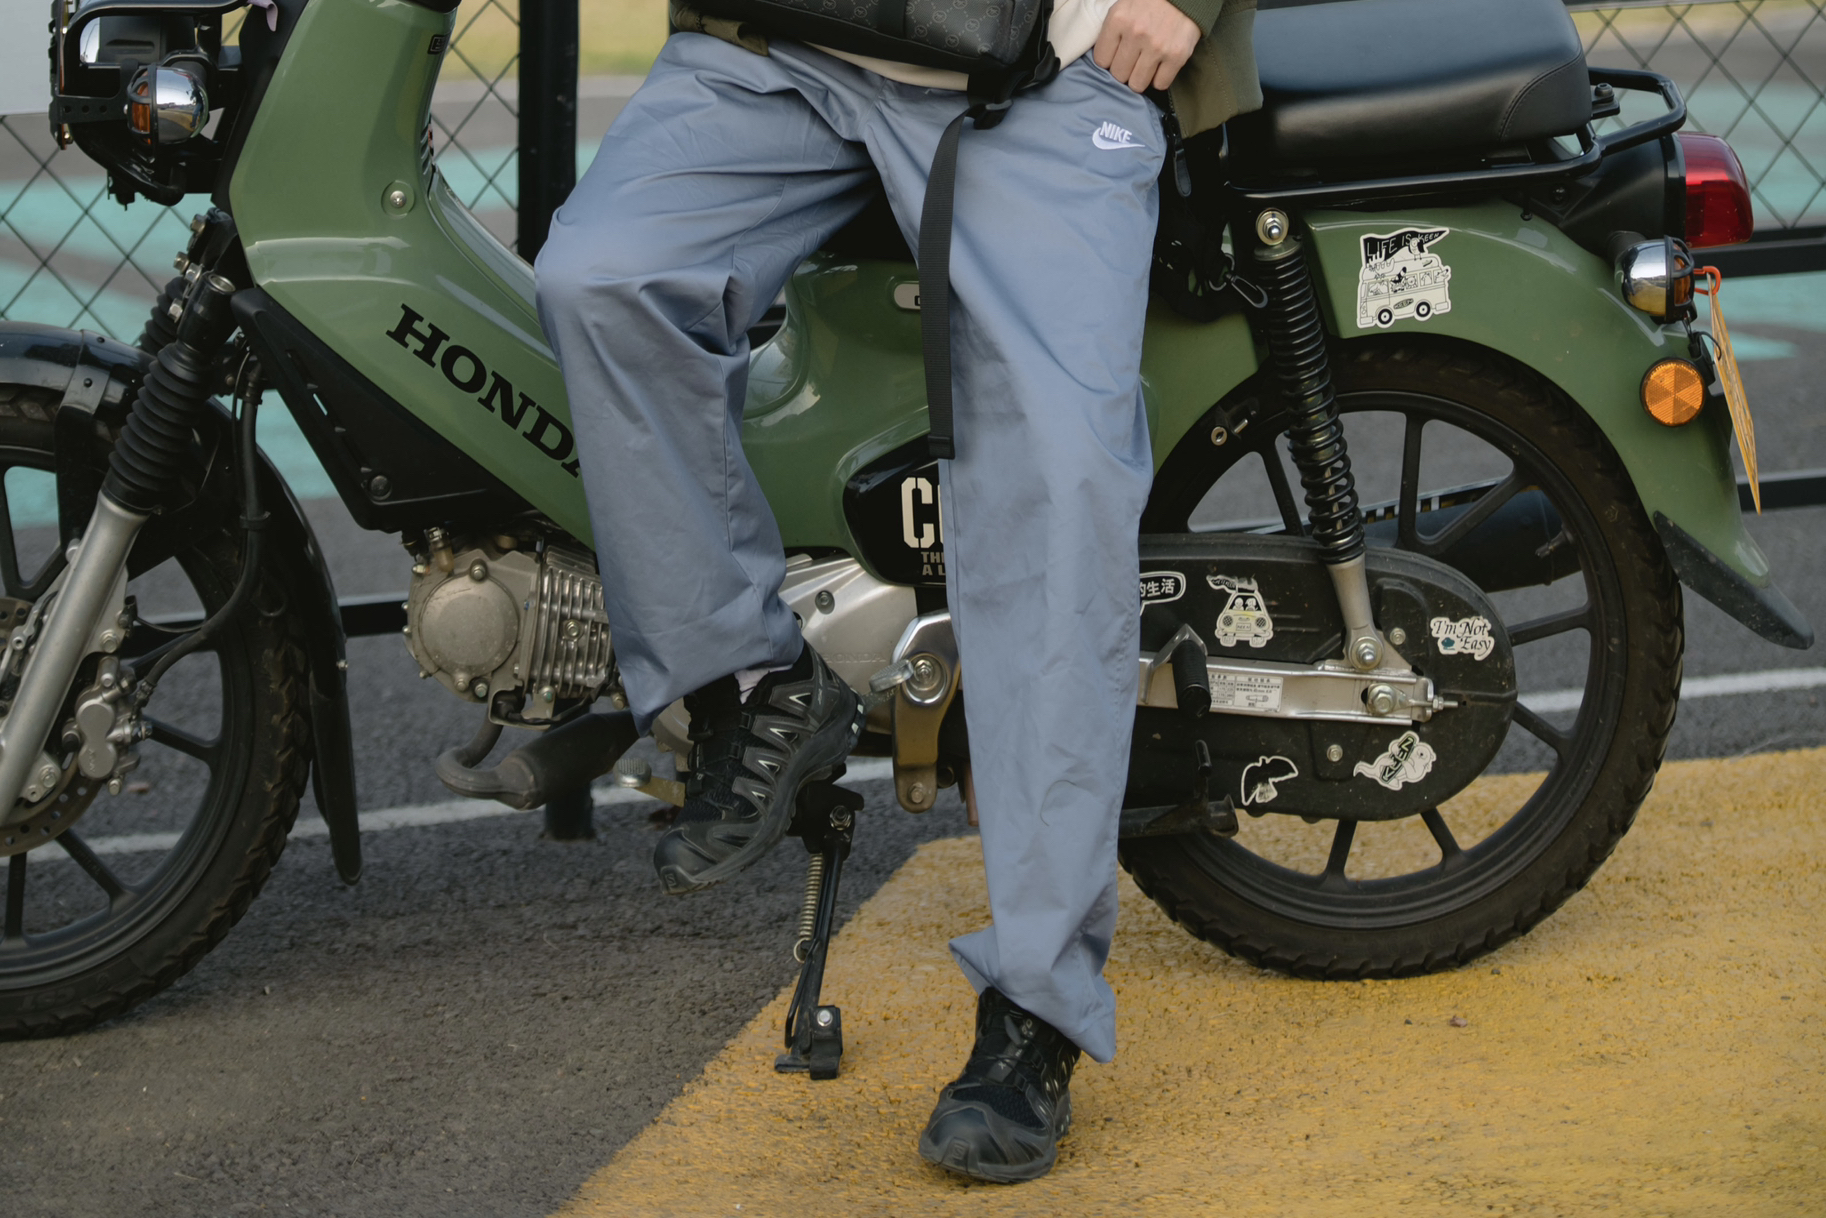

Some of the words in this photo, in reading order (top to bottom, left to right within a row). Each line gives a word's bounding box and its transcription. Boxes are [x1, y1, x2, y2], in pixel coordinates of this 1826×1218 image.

[1100, 121, 1133, 143] NIKE
[1367, 237, 1398, 257] LIFE
[1402, 233, 1412, 246] IS
[385, 303, 582, 479] HOND
[901, 476, 944, 549] C
[1433, 620, 1457, 635] I'm
[1456, 618, 1488, 639] Not
[1460, 636, 1491, 657] Easy
